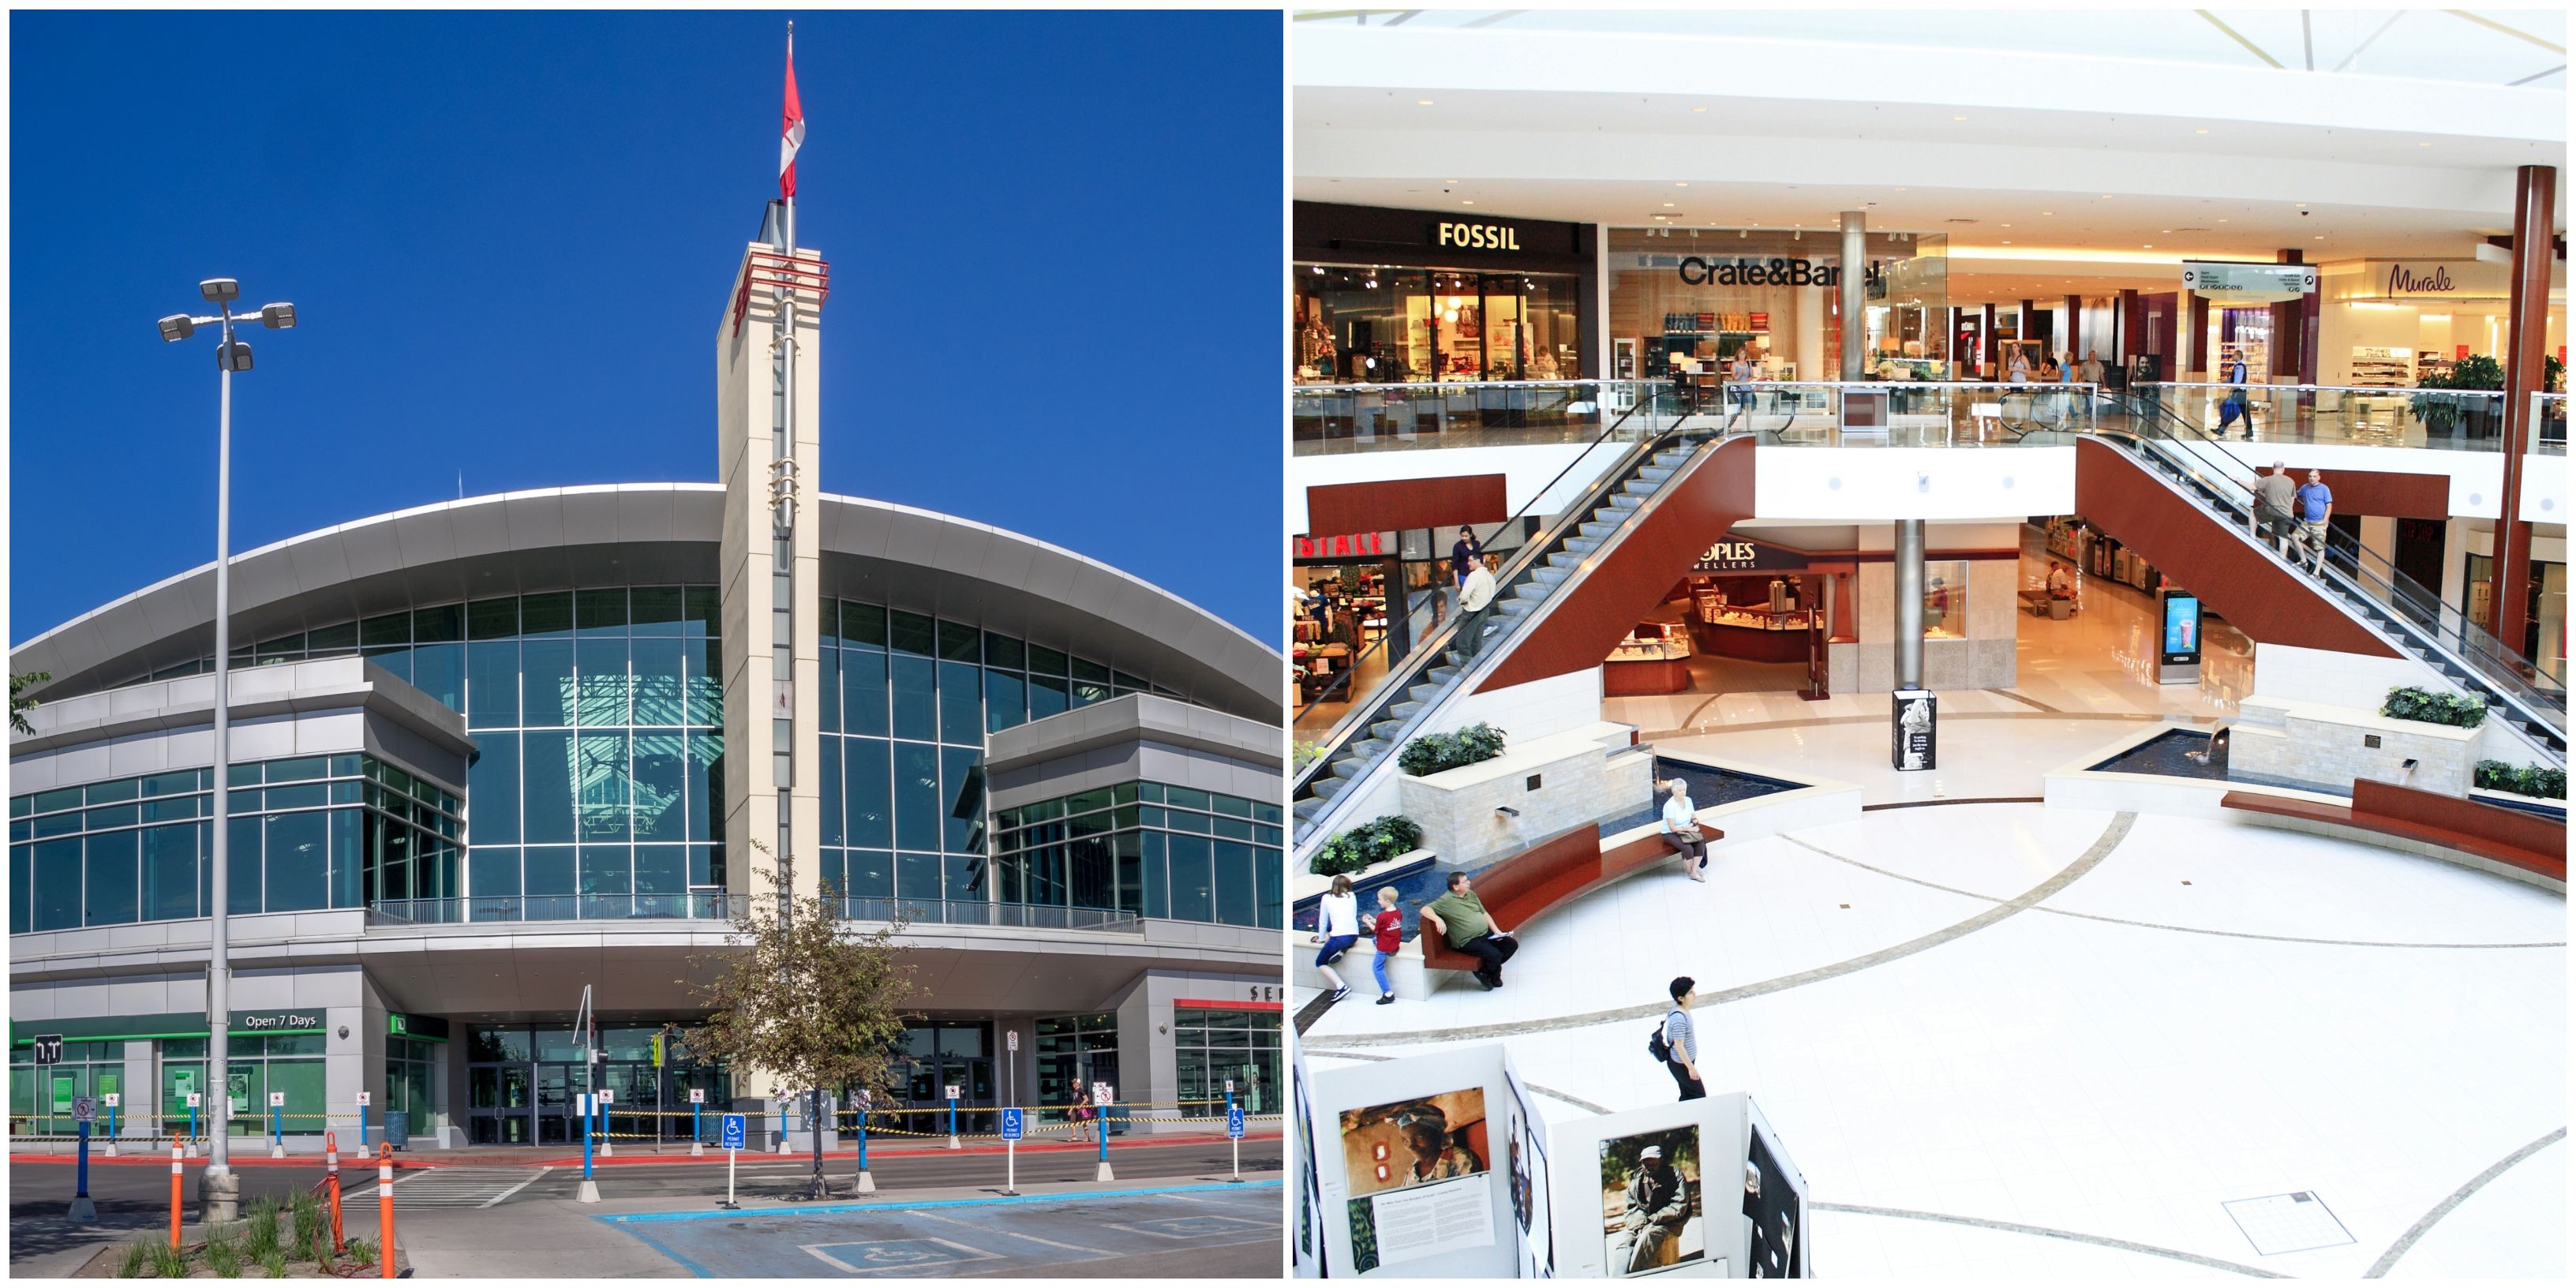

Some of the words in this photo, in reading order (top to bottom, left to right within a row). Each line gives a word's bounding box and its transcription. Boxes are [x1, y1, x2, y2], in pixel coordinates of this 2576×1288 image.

[1440, 223, 1520, 250] FOSSIL
[1679, 256, 1880, 286] Crate&Barl
[2388, 264, 2456, 299] Murale
[1699, 543, 1755, 561] OPLES
[1693, 561, 1755, 570] WELLERS
[245, 1016, 276, 1029] Open
[279, 1015, 286, 1026] 7
[290, 1015, 316, 1028] Days
